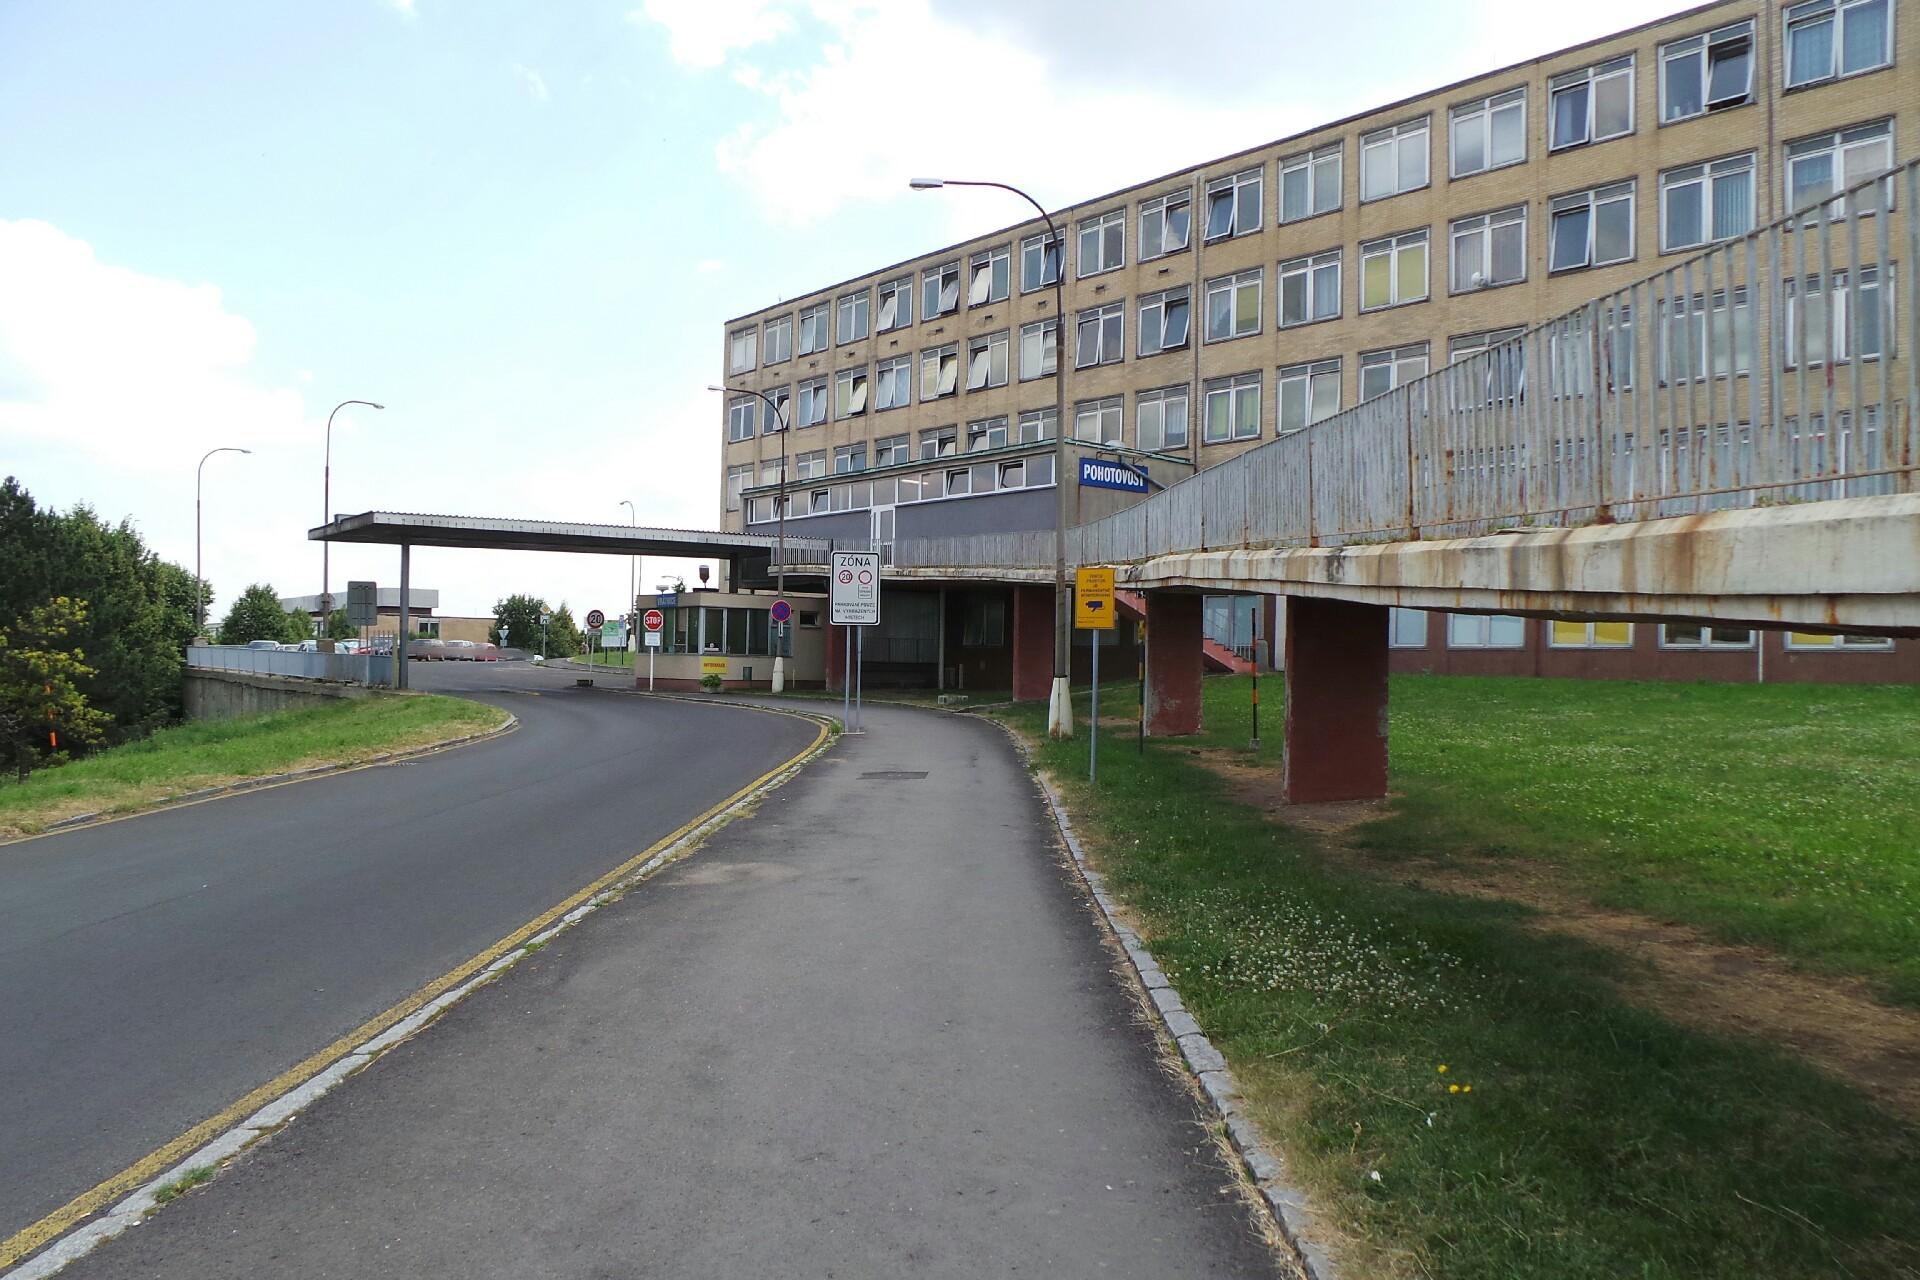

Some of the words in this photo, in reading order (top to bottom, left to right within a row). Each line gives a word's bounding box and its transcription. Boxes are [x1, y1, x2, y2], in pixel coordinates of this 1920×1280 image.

[840, 555, 871, 566] ZÓNA
[841, 573, 851, 581] 20
[591, 615, 600, 623] 20
[646, 616, 660, 624] STOP
